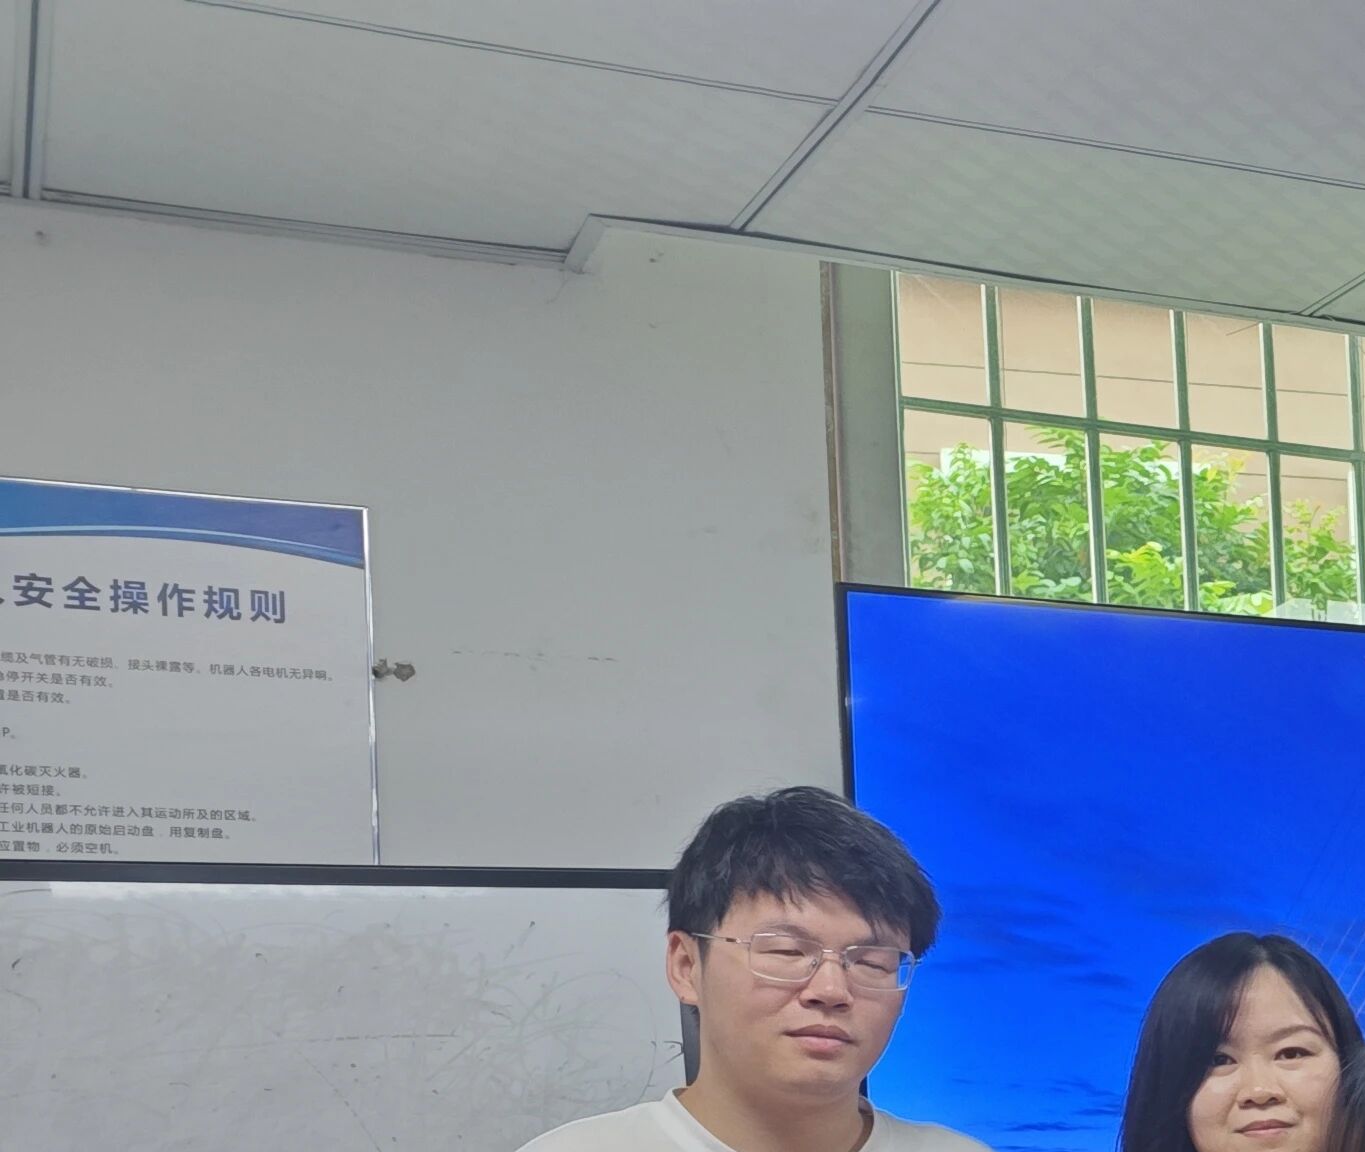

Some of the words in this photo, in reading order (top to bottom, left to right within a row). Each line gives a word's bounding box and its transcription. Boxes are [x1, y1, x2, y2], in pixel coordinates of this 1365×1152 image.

[0, 573, 287, 624] 安全操作规则
